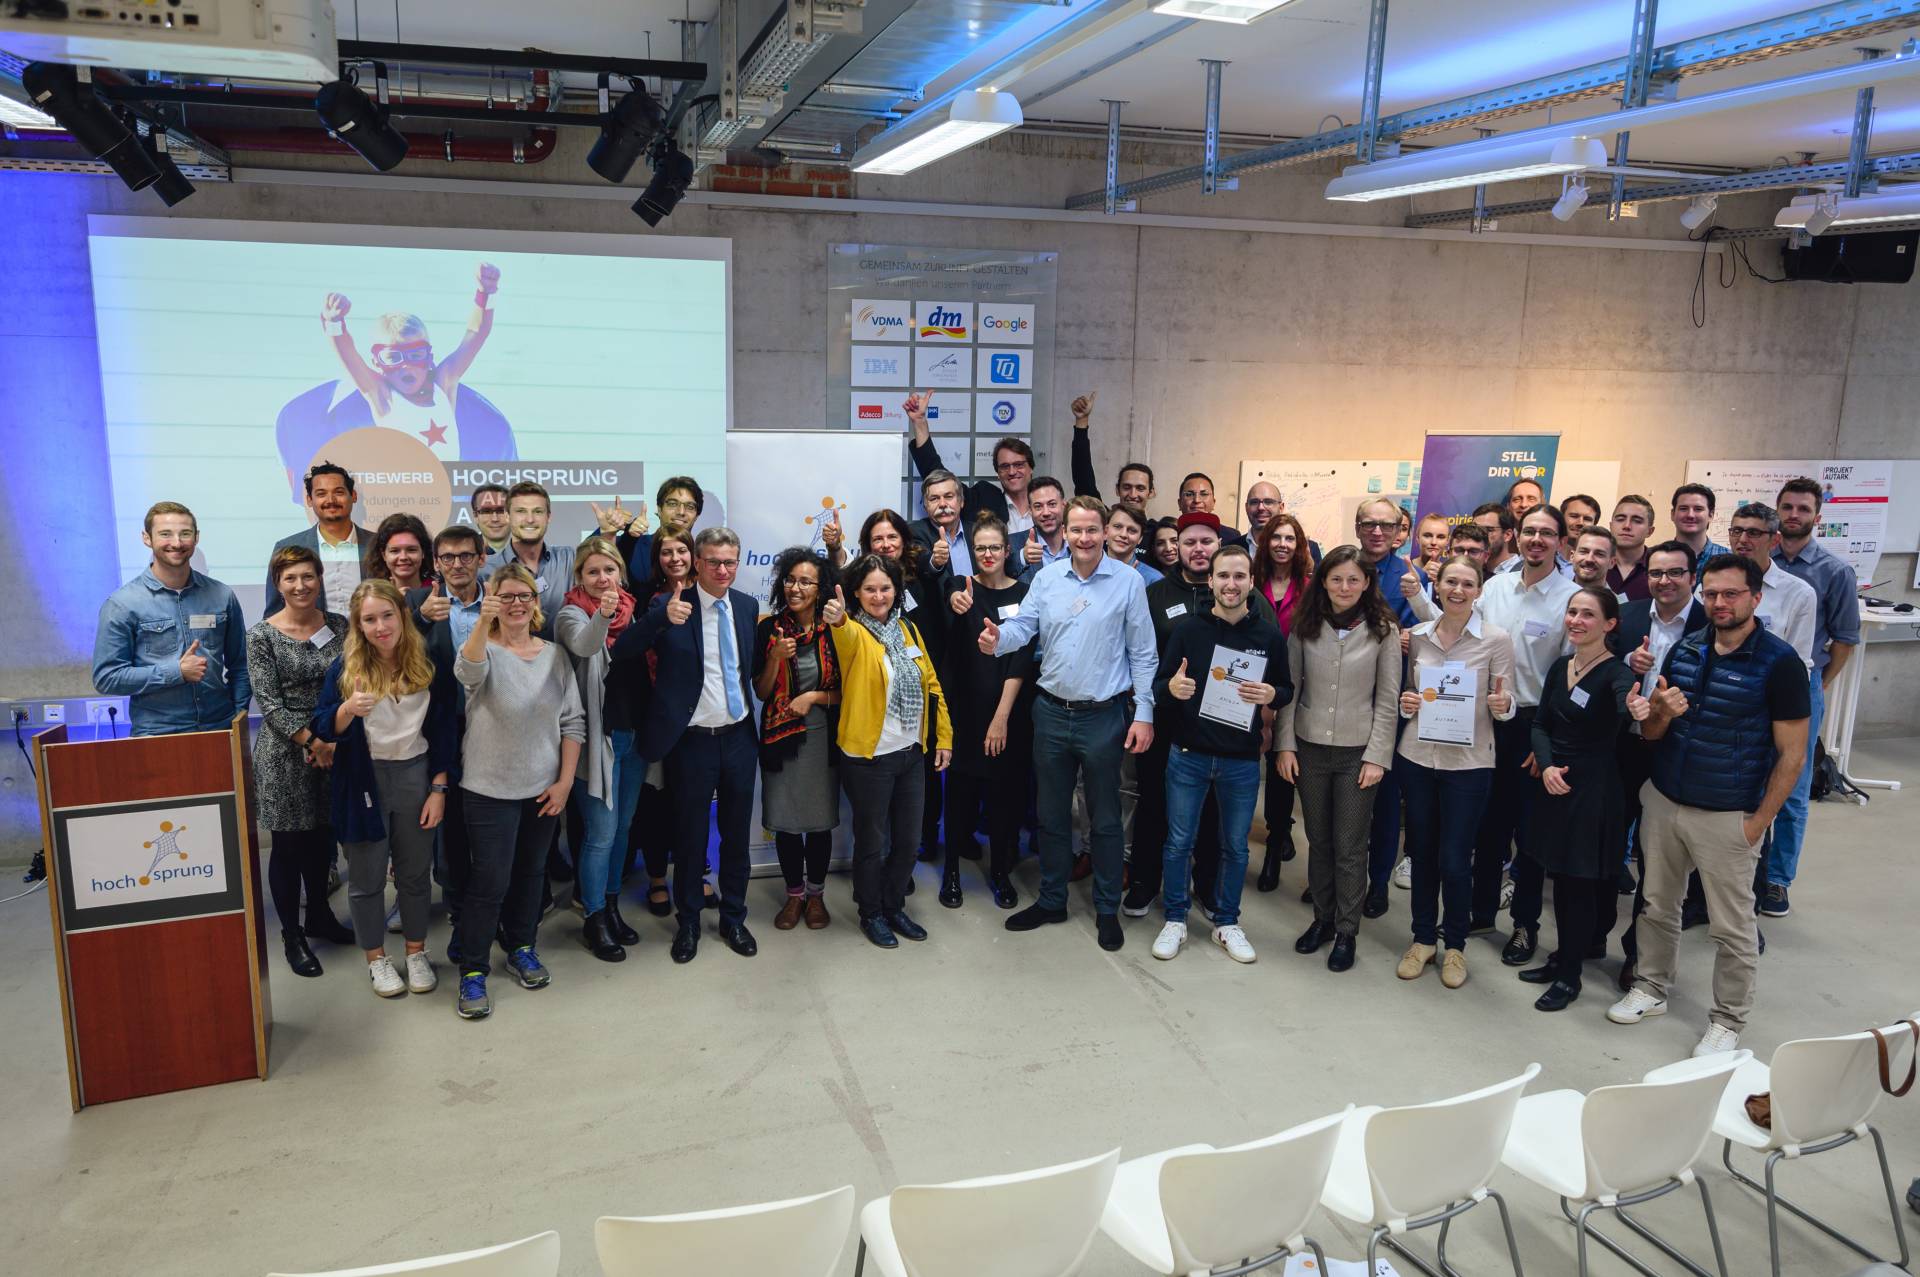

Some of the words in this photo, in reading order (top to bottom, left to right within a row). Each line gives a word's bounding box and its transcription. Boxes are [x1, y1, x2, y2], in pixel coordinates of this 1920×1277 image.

[859, 259, 921, 272] GEMEINSAM
[973, 264, 1029, 275] GESTALTEN
[872, 316, 903, 327] VDMA
[928, 306, 962, 327] dm
[983, 315, 1028, 332] Google
[864, 358, 898, 375] IBM
[995, 358, 1015, 380] TQ
[1501, 451, 1537, 462] STELL
[453, 468, 619, 486] HOCHSPRUNG
[1488, 466, 1510, 477] DIR
[1825, 466, 1854, 474] PROJEKT
[419, 497, 441, 506] aus
[92, 874, 136, 892] hoch
[153, 863, 213, 883] sprung
